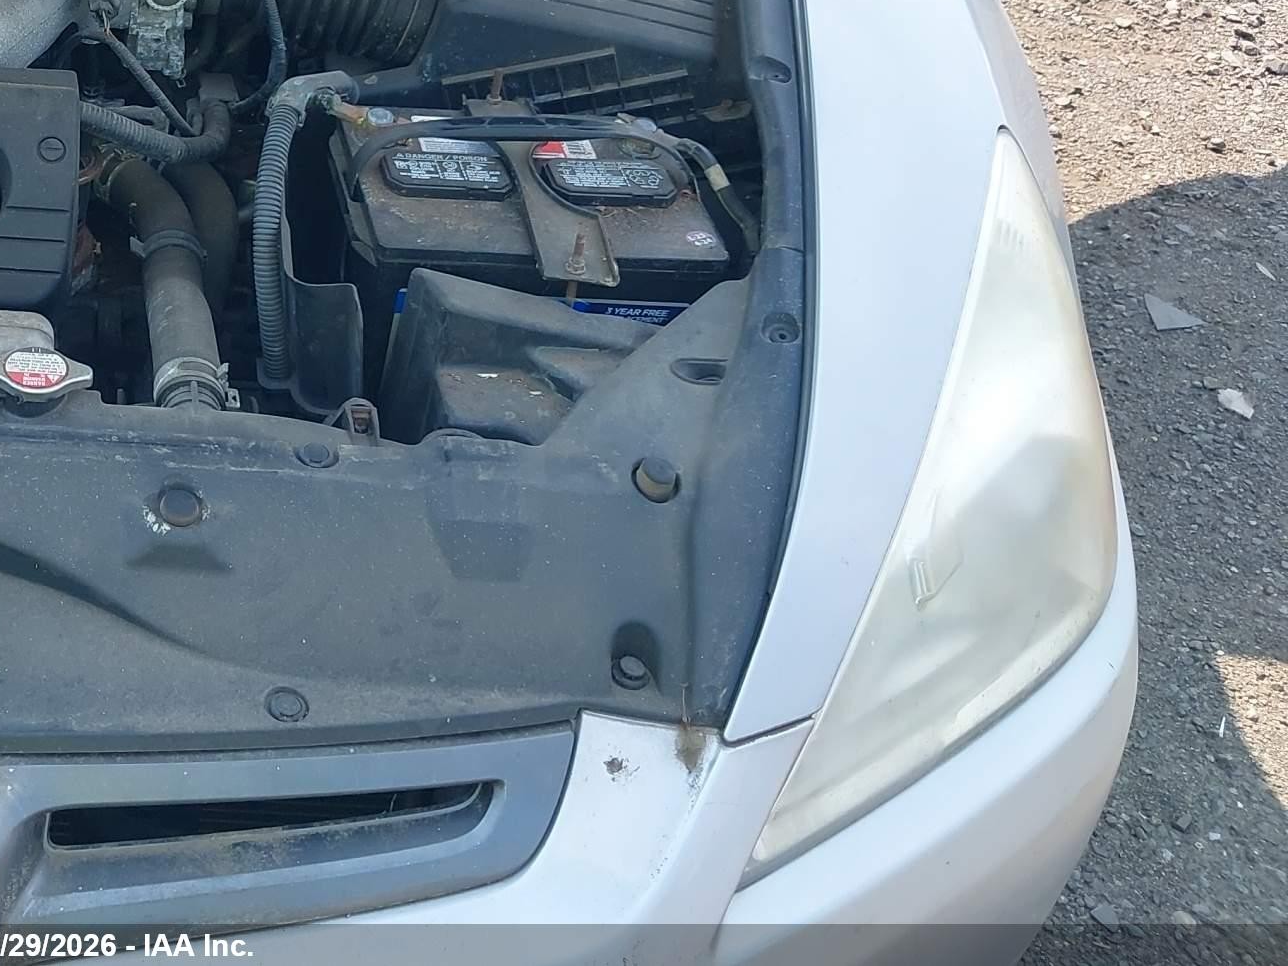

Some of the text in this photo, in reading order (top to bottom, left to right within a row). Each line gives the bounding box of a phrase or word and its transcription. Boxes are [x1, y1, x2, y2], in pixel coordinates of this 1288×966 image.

[406, 153, 444, 161] DANGER
[453, 154, 487, 162] POISON
[614, 307, 642, 316] YEAR
[641, 309, 670, 317] FREE
